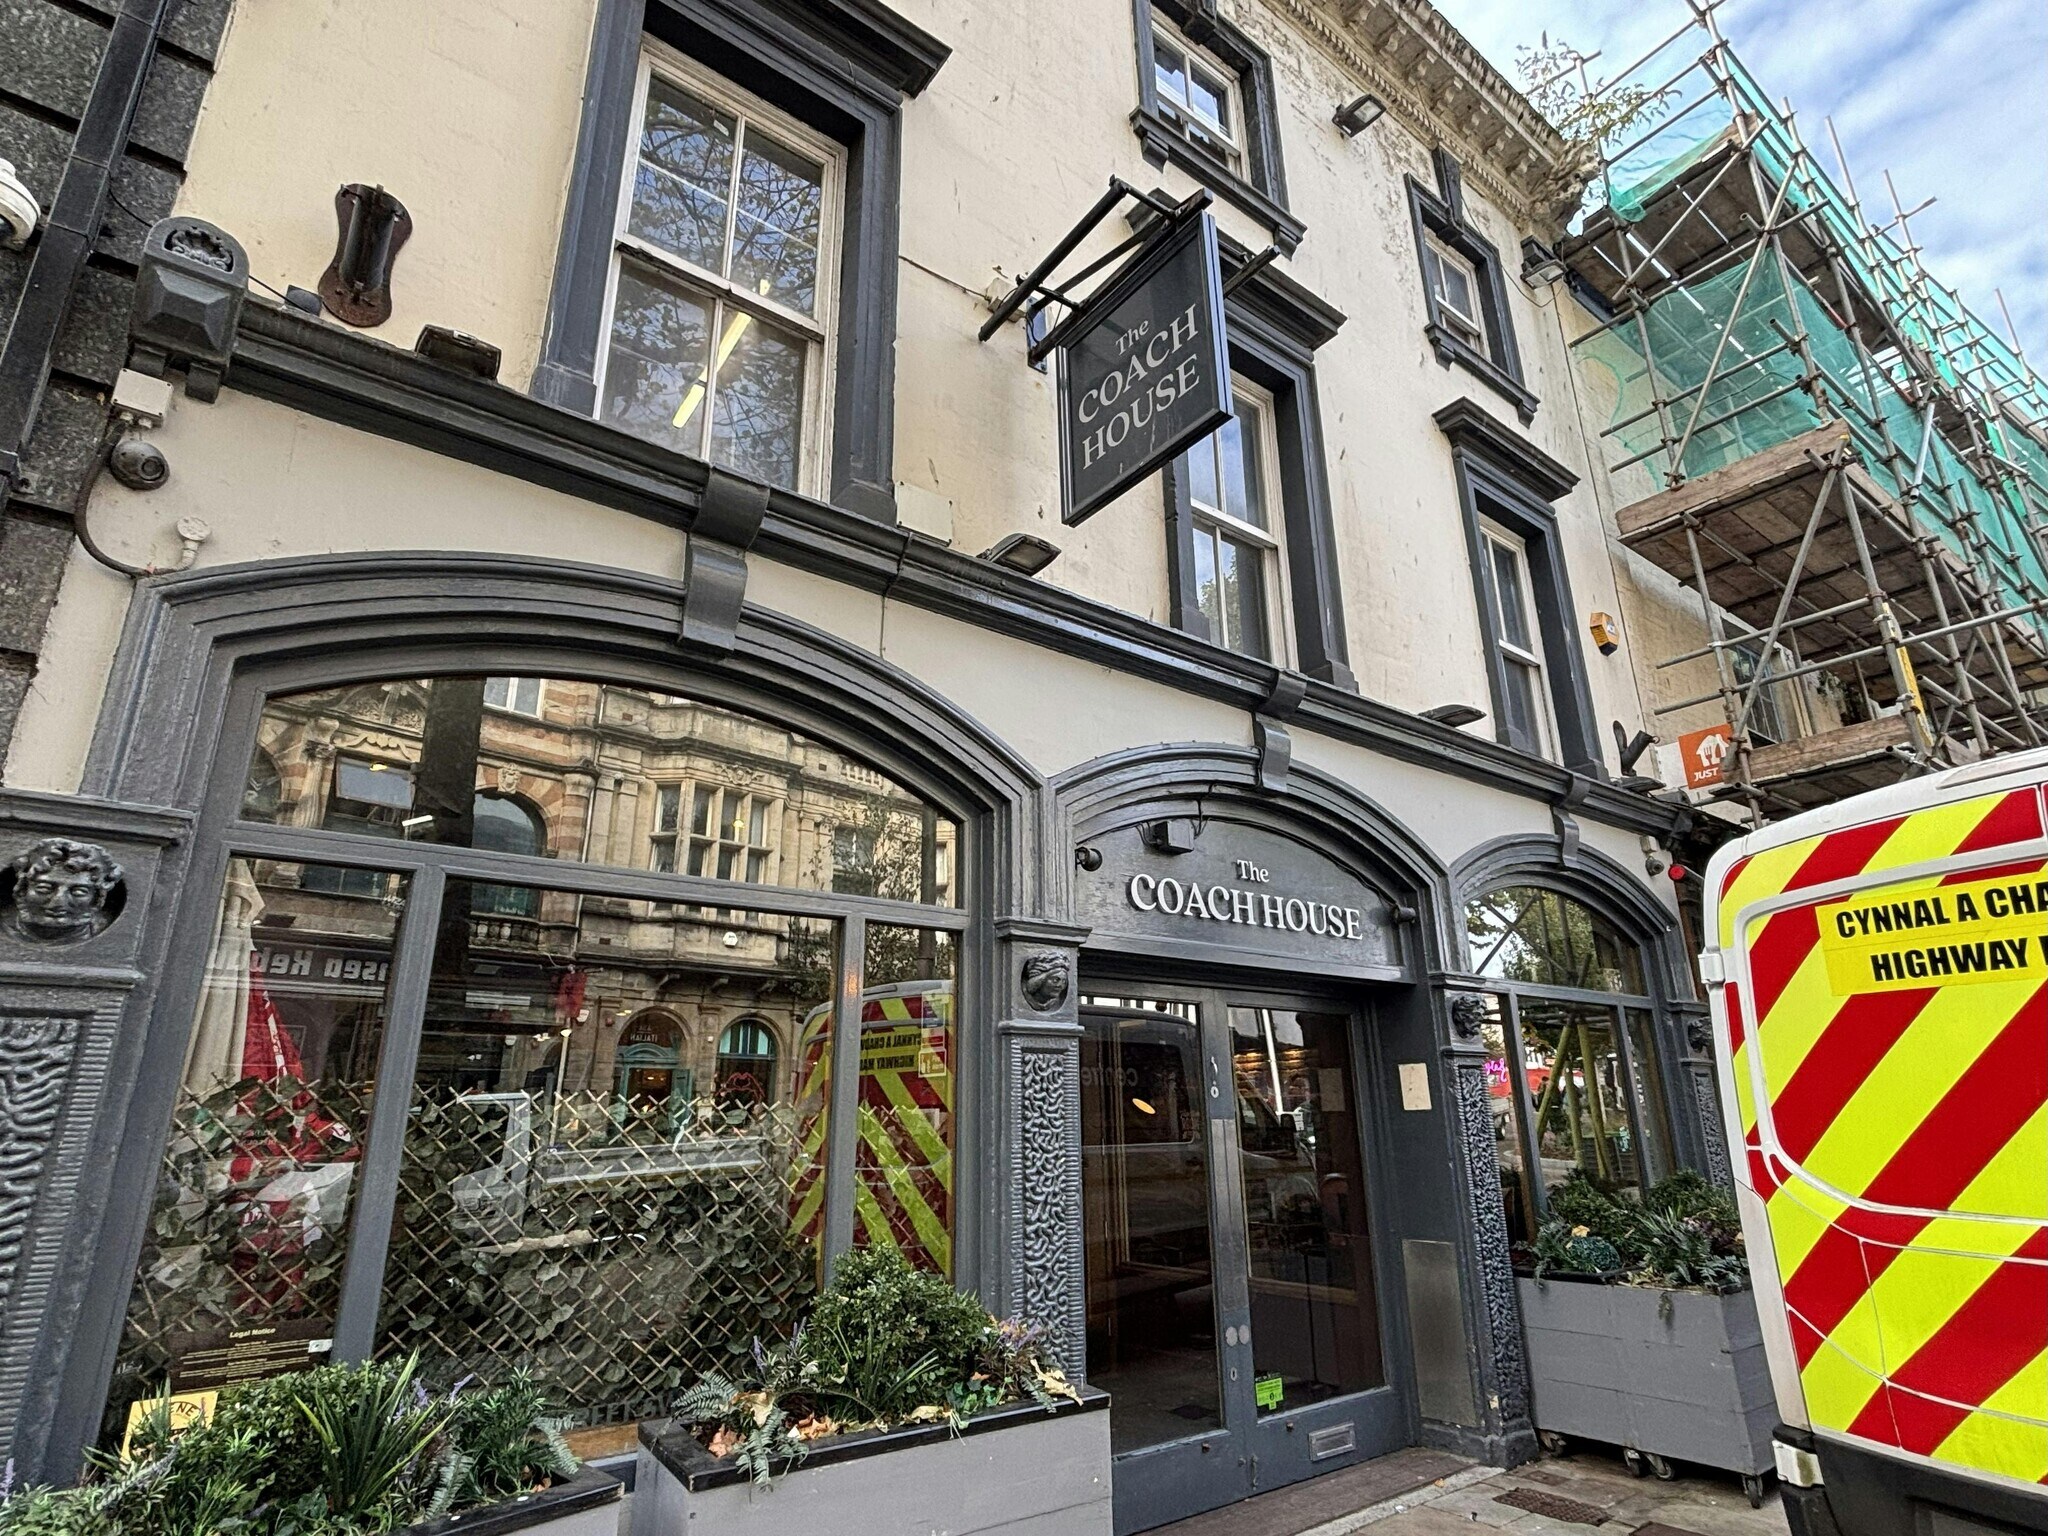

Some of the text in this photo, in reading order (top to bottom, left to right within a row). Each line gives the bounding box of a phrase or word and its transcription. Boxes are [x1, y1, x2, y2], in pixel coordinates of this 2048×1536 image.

[1115, 319, 1150, 357] The
[1078, 303, 1200, 424] COACH
[1082, 353, 1201, 470] HOUSE
[1693, 767, 1719, 782] JUST
[1236, 859, 1270, 883] The
[1130, 873, 1364, 940] COACH HOUSE
[1836, 897, 1950, 939] CYNNAL
[1957, 893, 1980, 922] A
[1870, 937, 2028, 982] HIGHWAY
